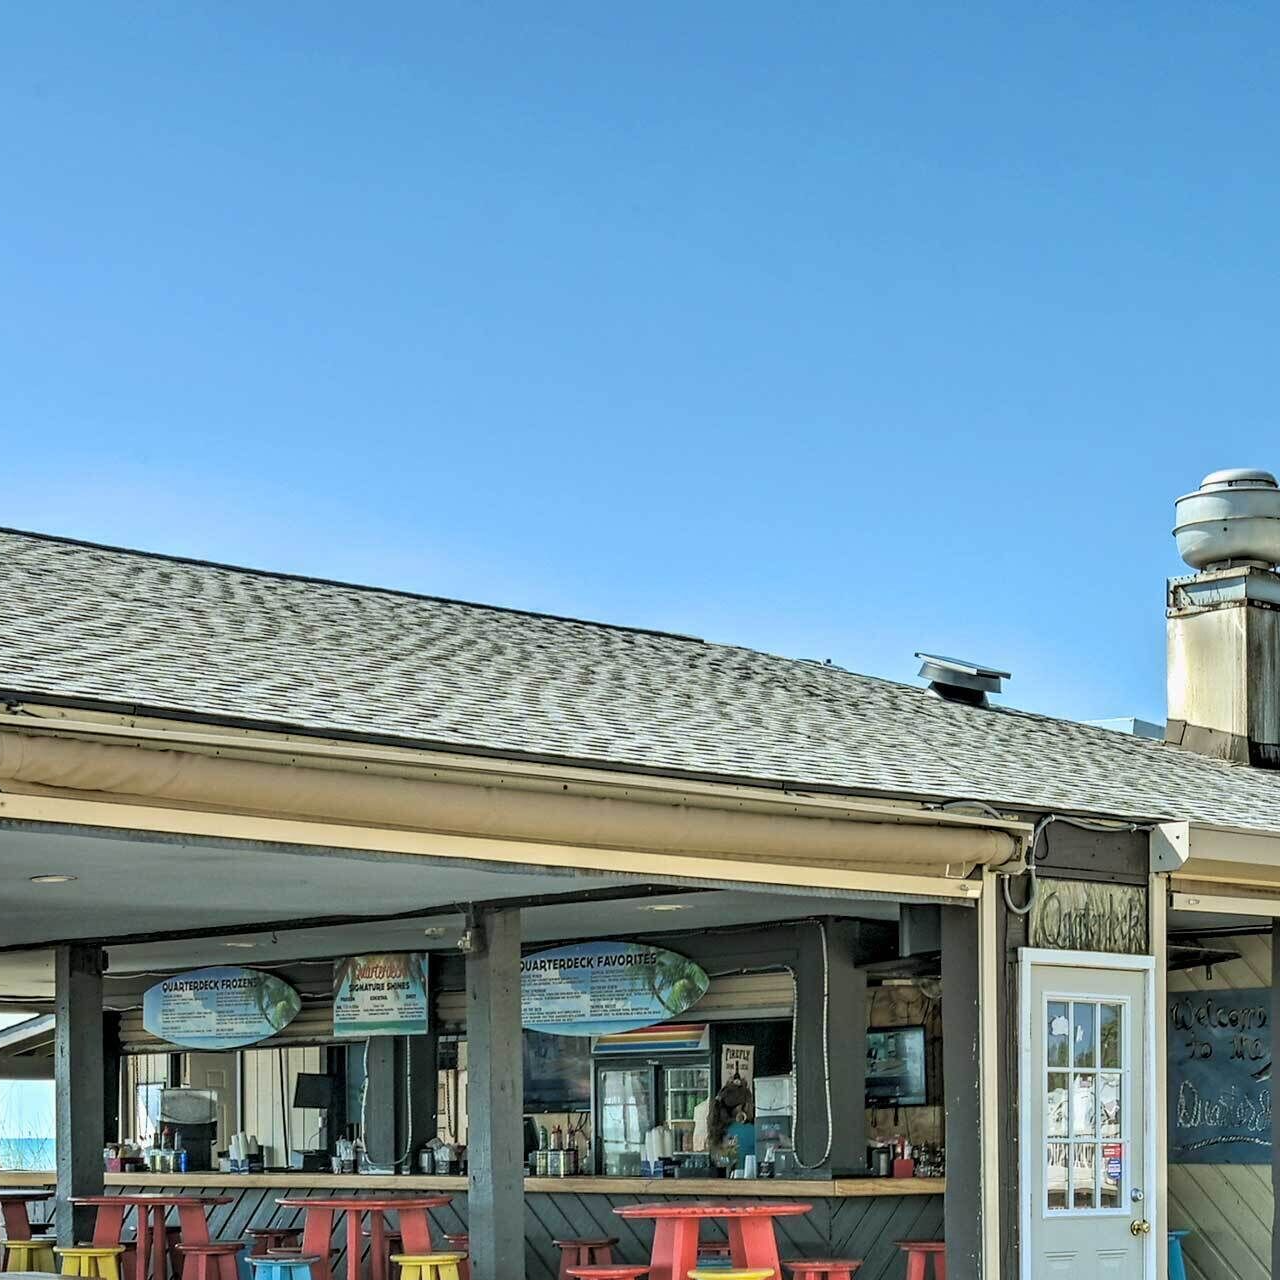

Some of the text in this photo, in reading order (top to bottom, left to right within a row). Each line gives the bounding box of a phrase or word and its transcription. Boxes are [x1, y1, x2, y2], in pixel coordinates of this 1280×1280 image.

[597, 952, 656, 967] FAVORITES
[162, 979, 219, 993] QUARTERDECK
[349, 982, 385, 992] SIGNATURE
[725, 1048, 750, 1062] FIREFLY
